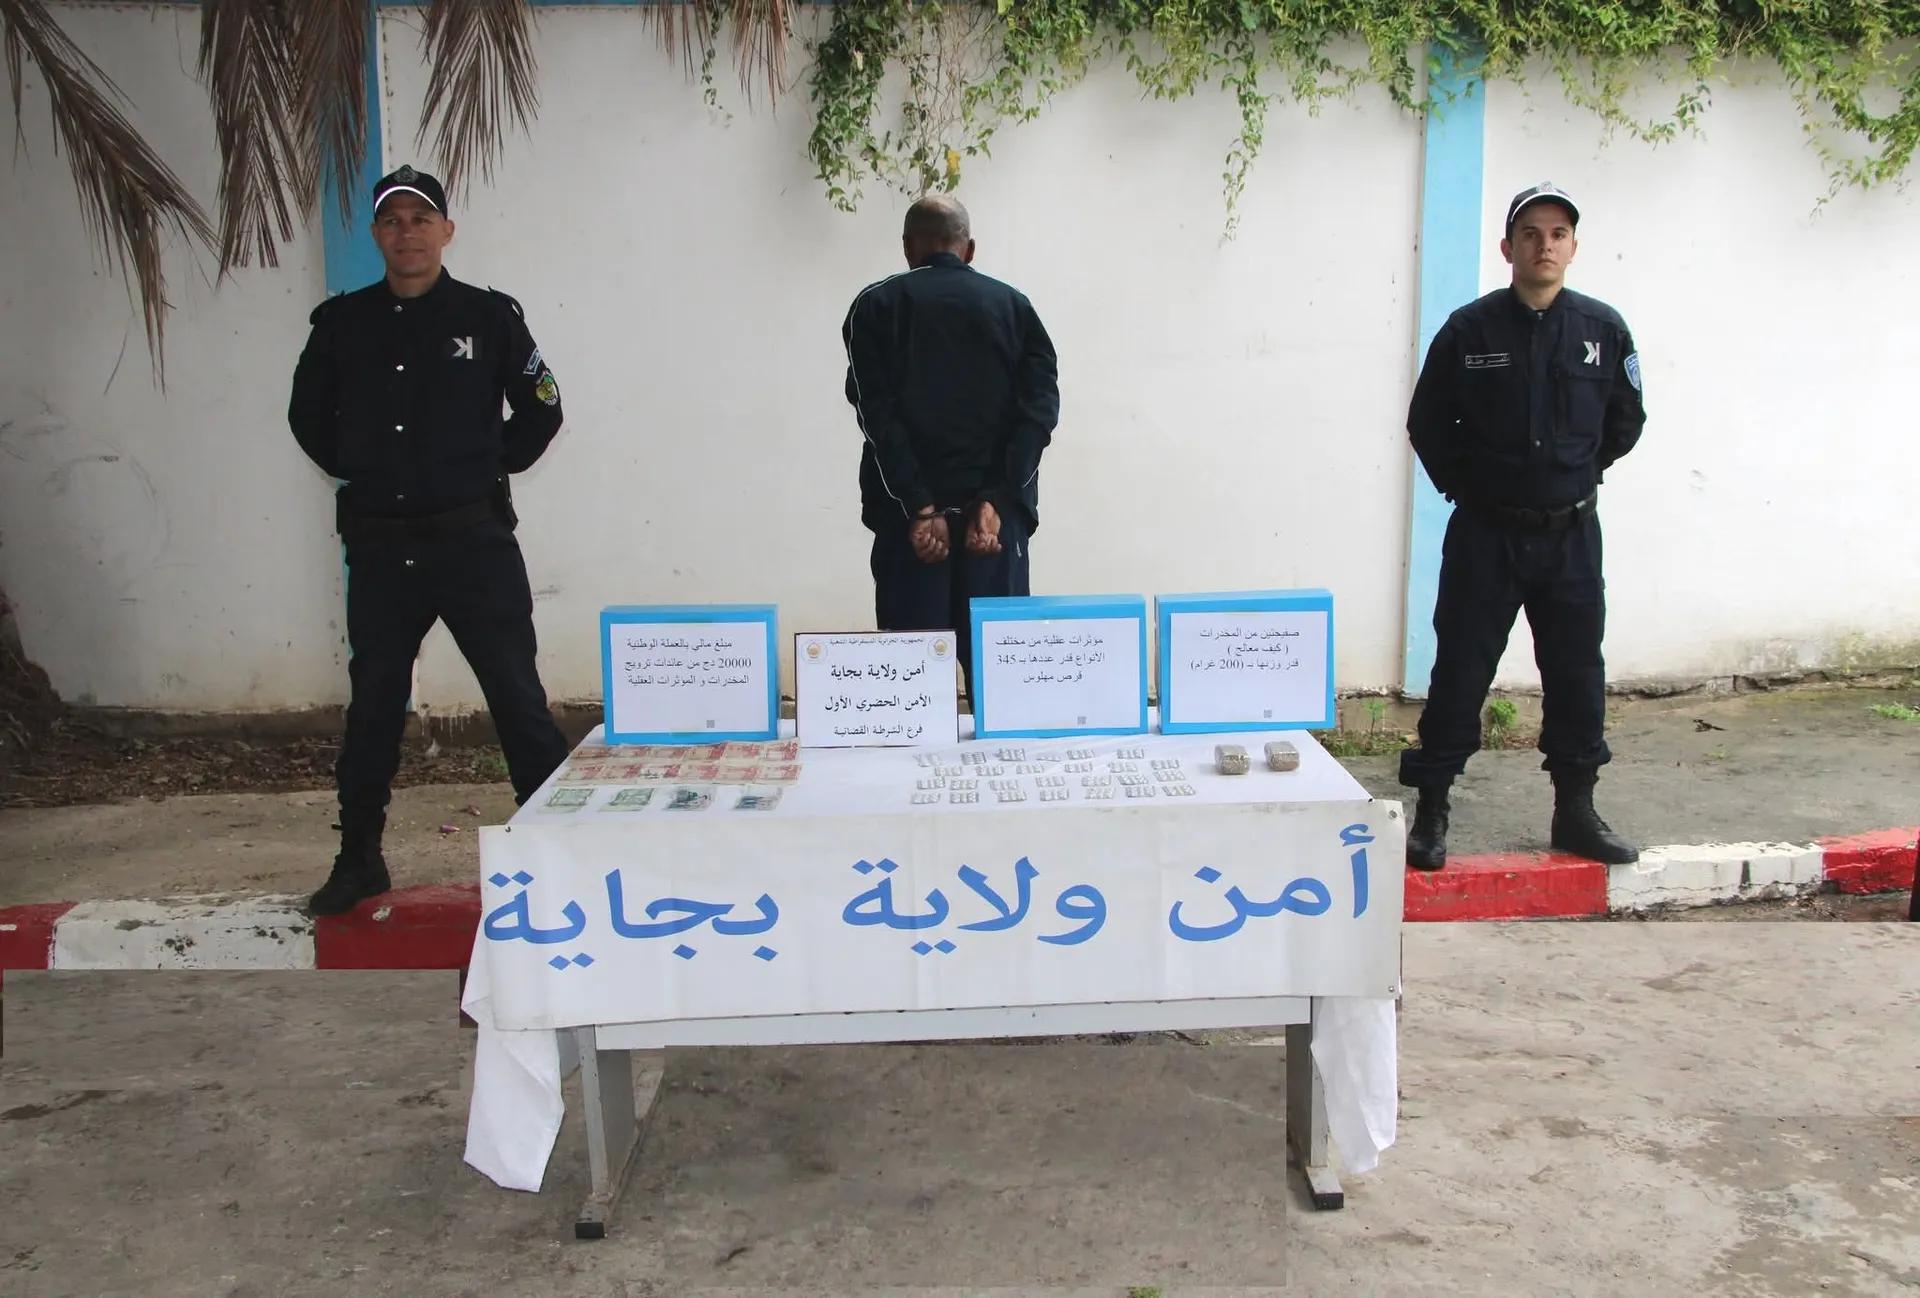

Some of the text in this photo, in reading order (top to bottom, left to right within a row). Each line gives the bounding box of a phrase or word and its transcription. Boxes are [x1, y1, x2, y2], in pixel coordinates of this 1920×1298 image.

[1200, 627, 1241, 640] المخدرات
[1245, 630, 1257, 639] من
[627, 638, 658, 650] الوطنية
[660, 638, 689, 650] بالعملة
[713, 638, 732, 651] مبلغ
[996, 635, 1026, 646] مختلف
[1029, 637, 1041, 647] من
[687, 660, 700, 669] من
[718, 657, 752, 669] 20000
[996, 653, 1017, 665] 345
[1029, 653, 1054, 664] عددها
[1059, 653, 1073, 664] قدر
[1286, 658, 1300, 671] قدر
[624, 659, 651, 671] ترويج
[702, 660, 715, 671] دج
[831, 660, 925, 681] أمن ولاية بجاية
[628, 674, 654, 687] العقلية
[708, 674, 749, 687] المخدرات
[1023, 671, 1083, 683] قرص مهلوس
[825, 693, 931, 712] الأمن الحضري الأول
[872, 724, 903, 738] الشرطة
[907, 724, 923, 738] فرع
[484, 824, 1372, 969] أمن ولاية بجاية
